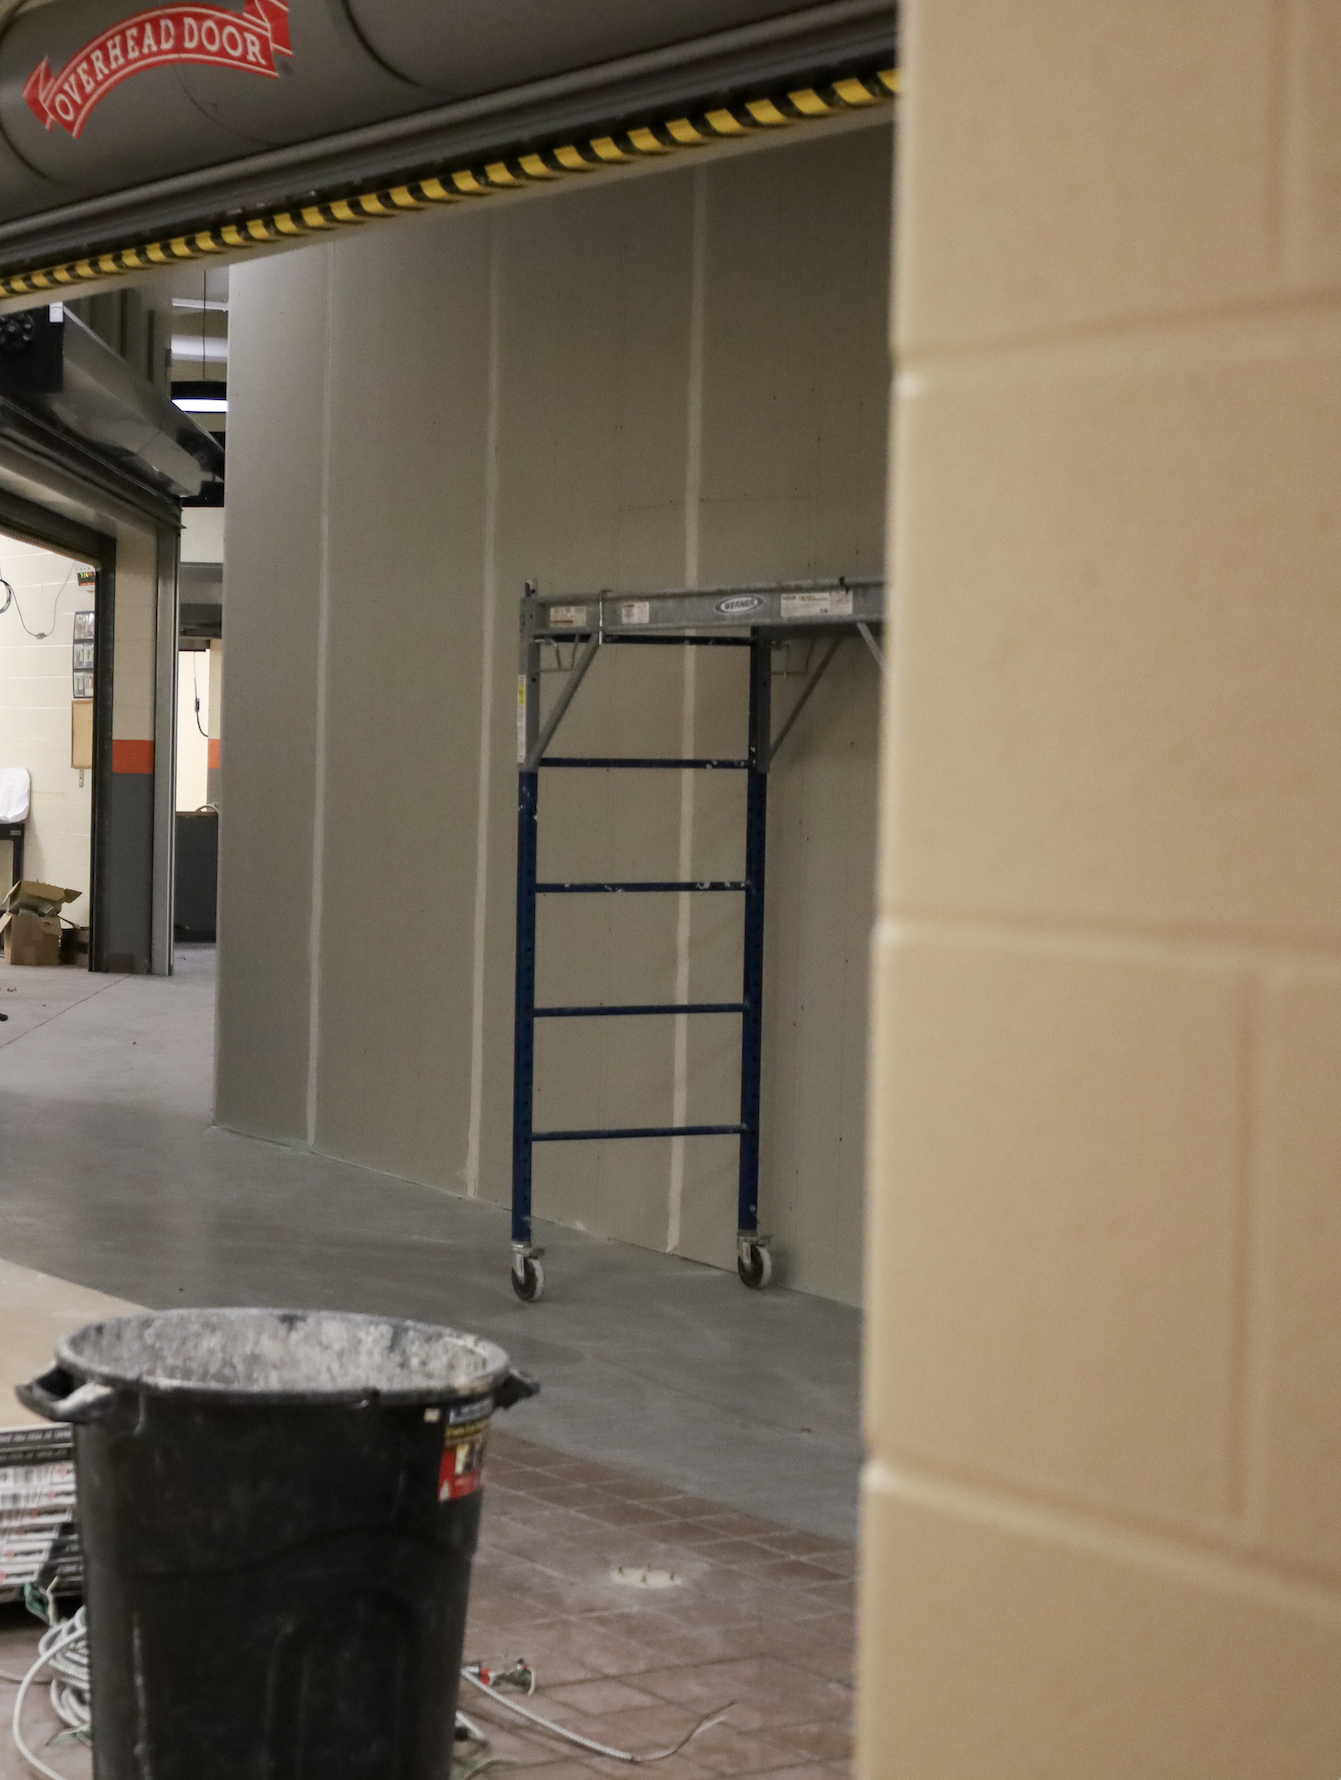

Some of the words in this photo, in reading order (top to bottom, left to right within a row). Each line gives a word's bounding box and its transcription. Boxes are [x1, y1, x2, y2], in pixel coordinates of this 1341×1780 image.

[54, 18, 176, 121] OVERHEAD
[182, 16, 266, 65] DOOR
[724, 599, 755, 610] WERNER
